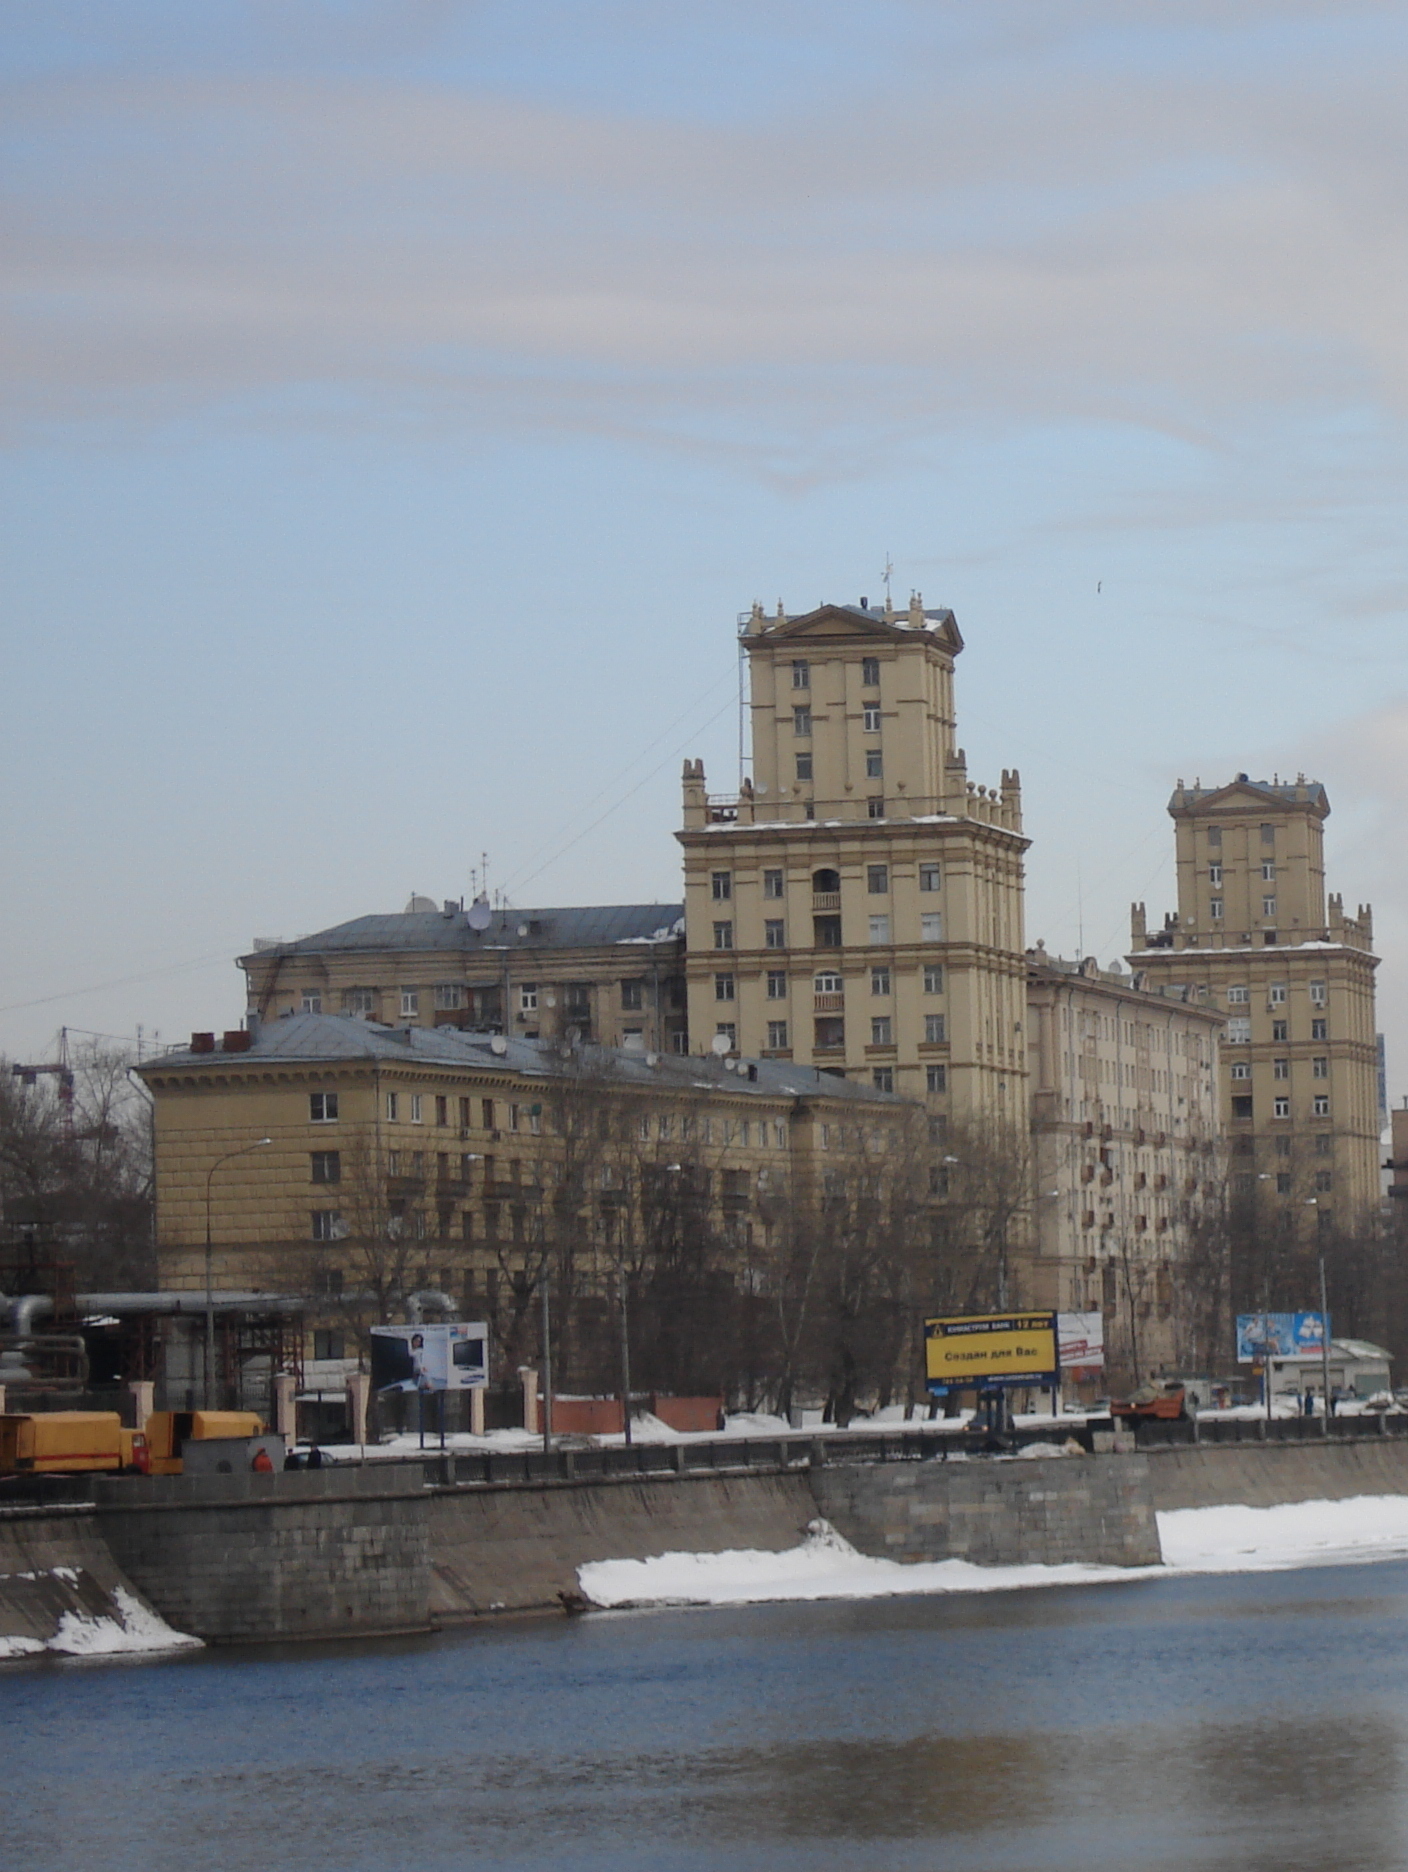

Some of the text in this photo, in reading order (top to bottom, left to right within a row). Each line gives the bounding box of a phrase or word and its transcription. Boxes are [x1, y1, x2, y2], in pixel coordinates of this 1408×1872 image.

[945, 1347, 1038, 1362] Создан для Вас
